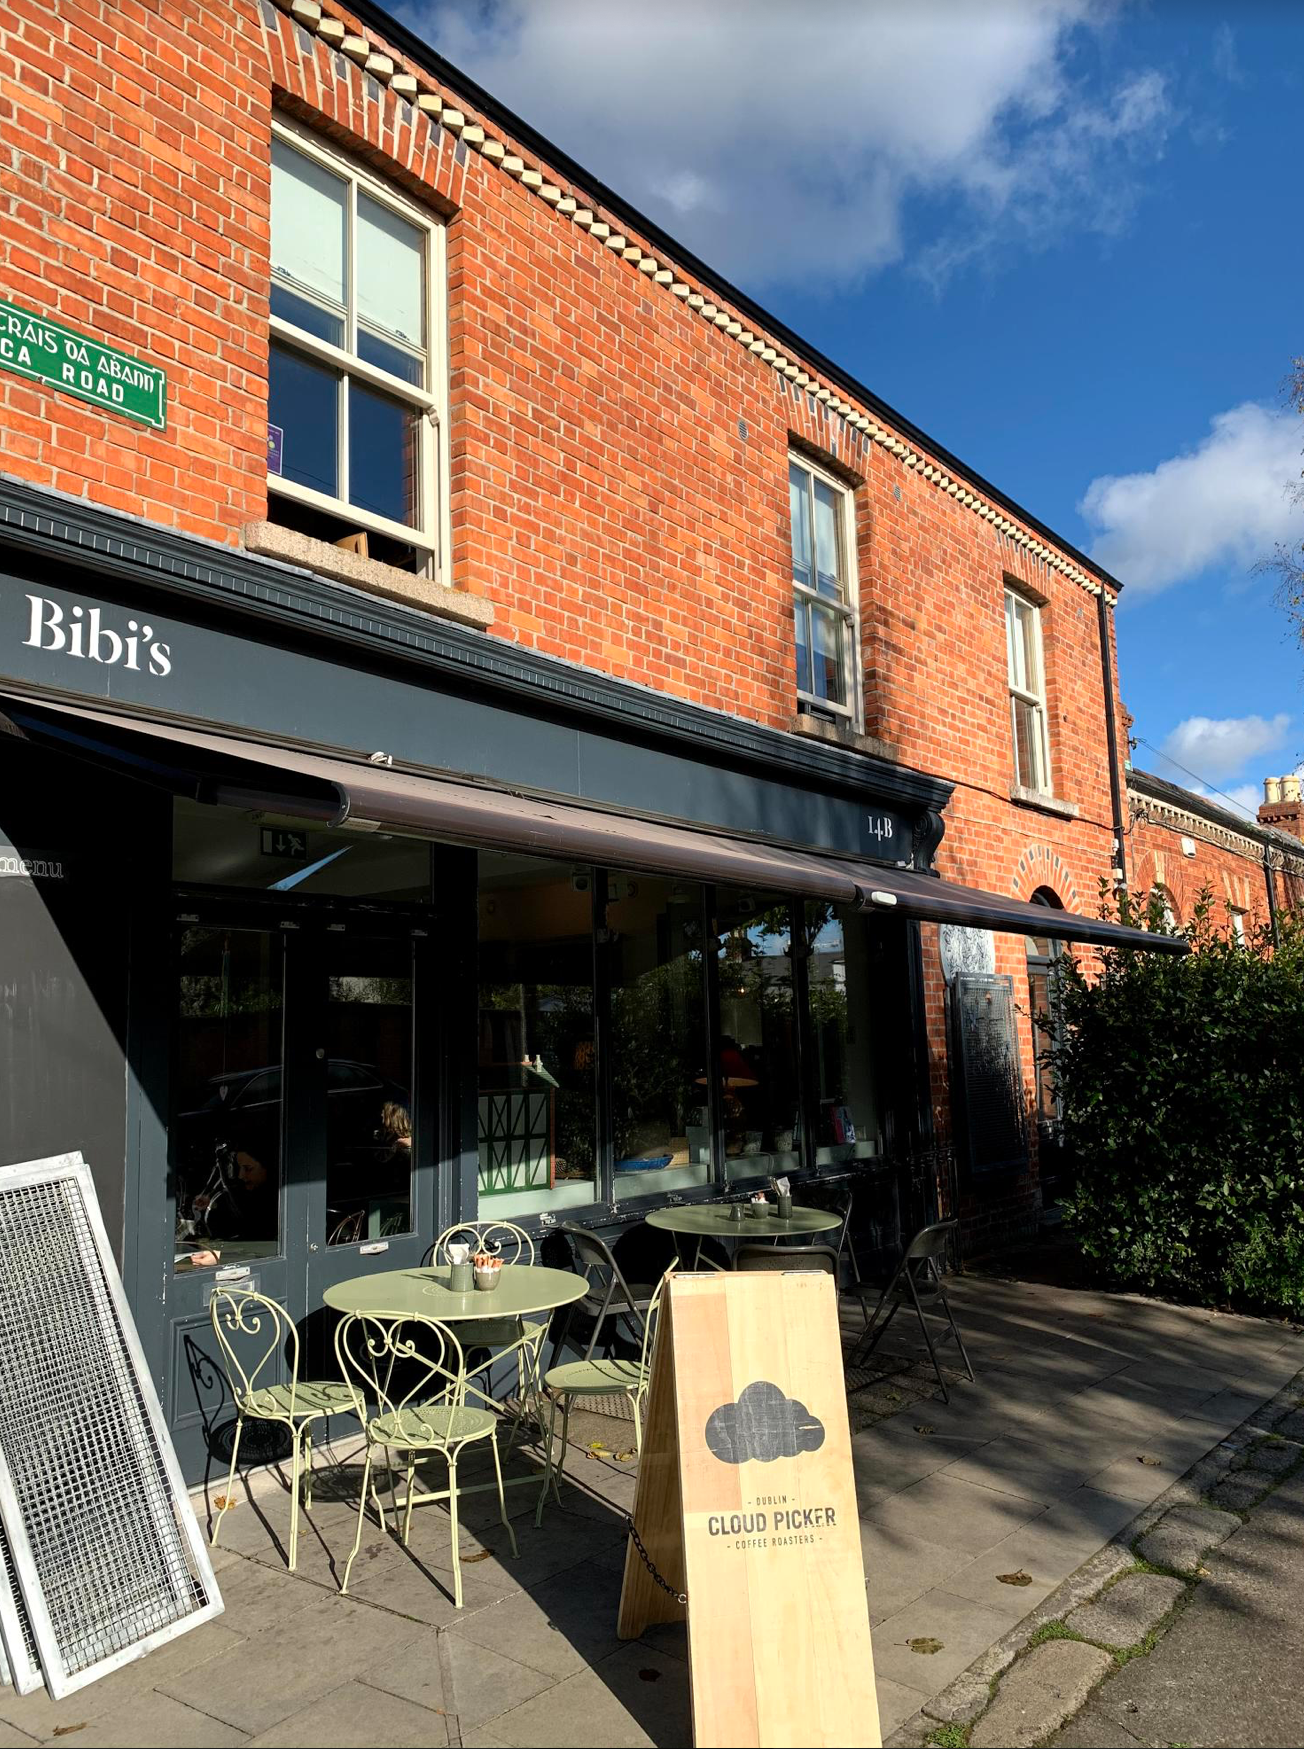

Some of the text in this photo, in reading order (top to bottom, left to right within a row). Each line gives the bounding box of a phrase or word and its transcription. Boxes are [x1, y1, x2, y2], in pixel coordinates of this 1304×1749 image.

[62, 363, 124, 403] ROAD
[21, 594, 172, 677] Bibi's
[867, 815, 893, 842] 14B
[0, 856, 64, 879] menu
[756, 1495, 788, 1506] DUBLIN
[708, 1507, 837, 1536] CLOUD PICKER
[735, 1534, 815, 1550] COFFEE ROASTERS
